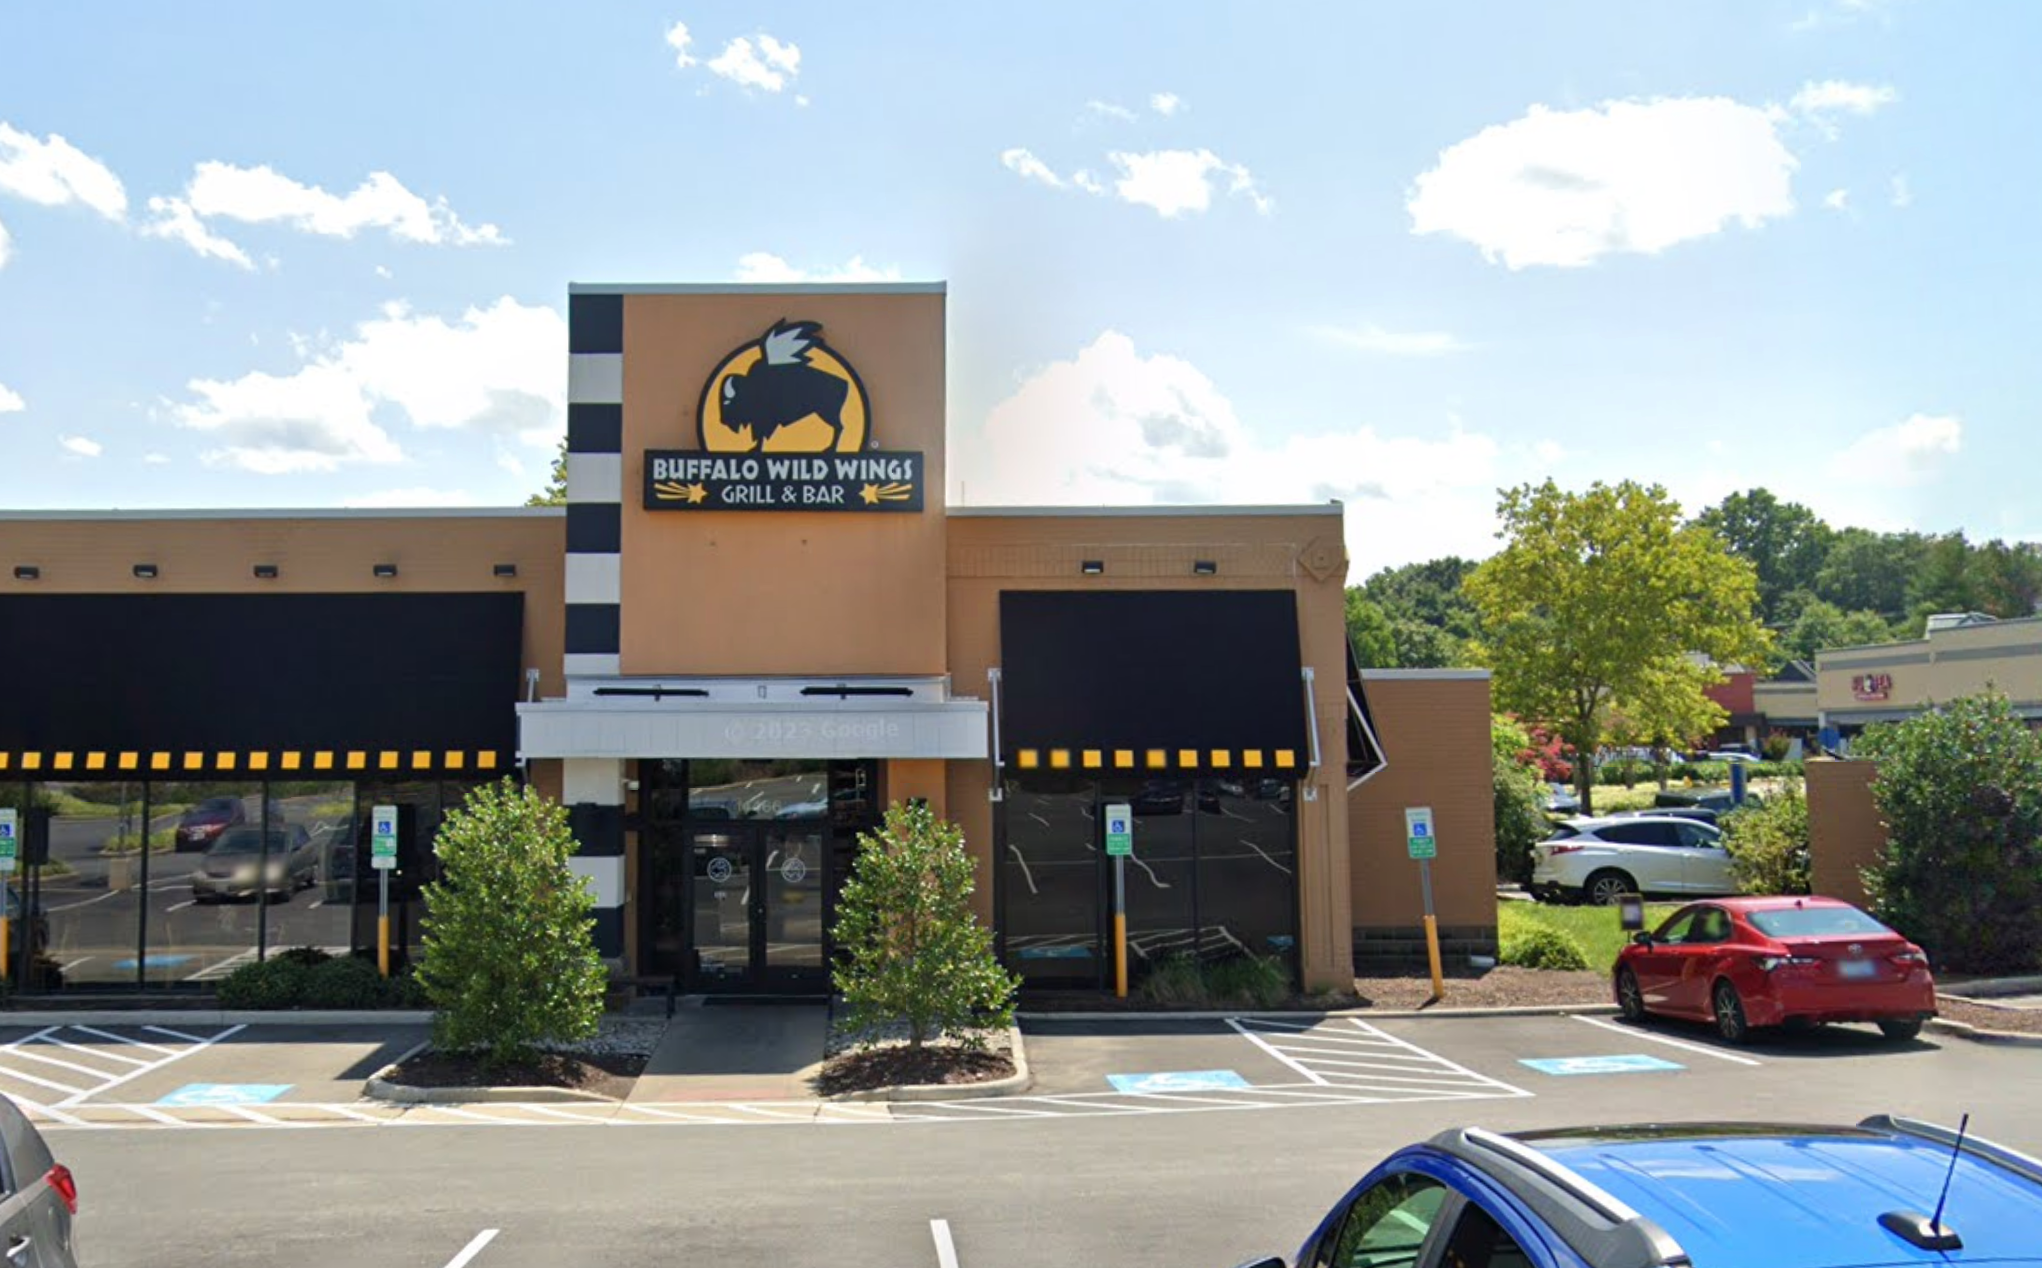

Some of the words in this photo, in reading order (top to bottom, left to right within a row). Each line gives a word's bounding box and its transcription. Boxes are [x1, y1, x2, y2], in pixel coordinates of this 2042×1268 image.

[653, 459, 759, 480] BUFFALO
[767, 459, 829, 480] WILD
[835, 459, 912, 480] WINGS
[721, 485, 775, 504] GRILL
[781, 485, 797, 504] &
[803, 485, 844, 504] BAR
